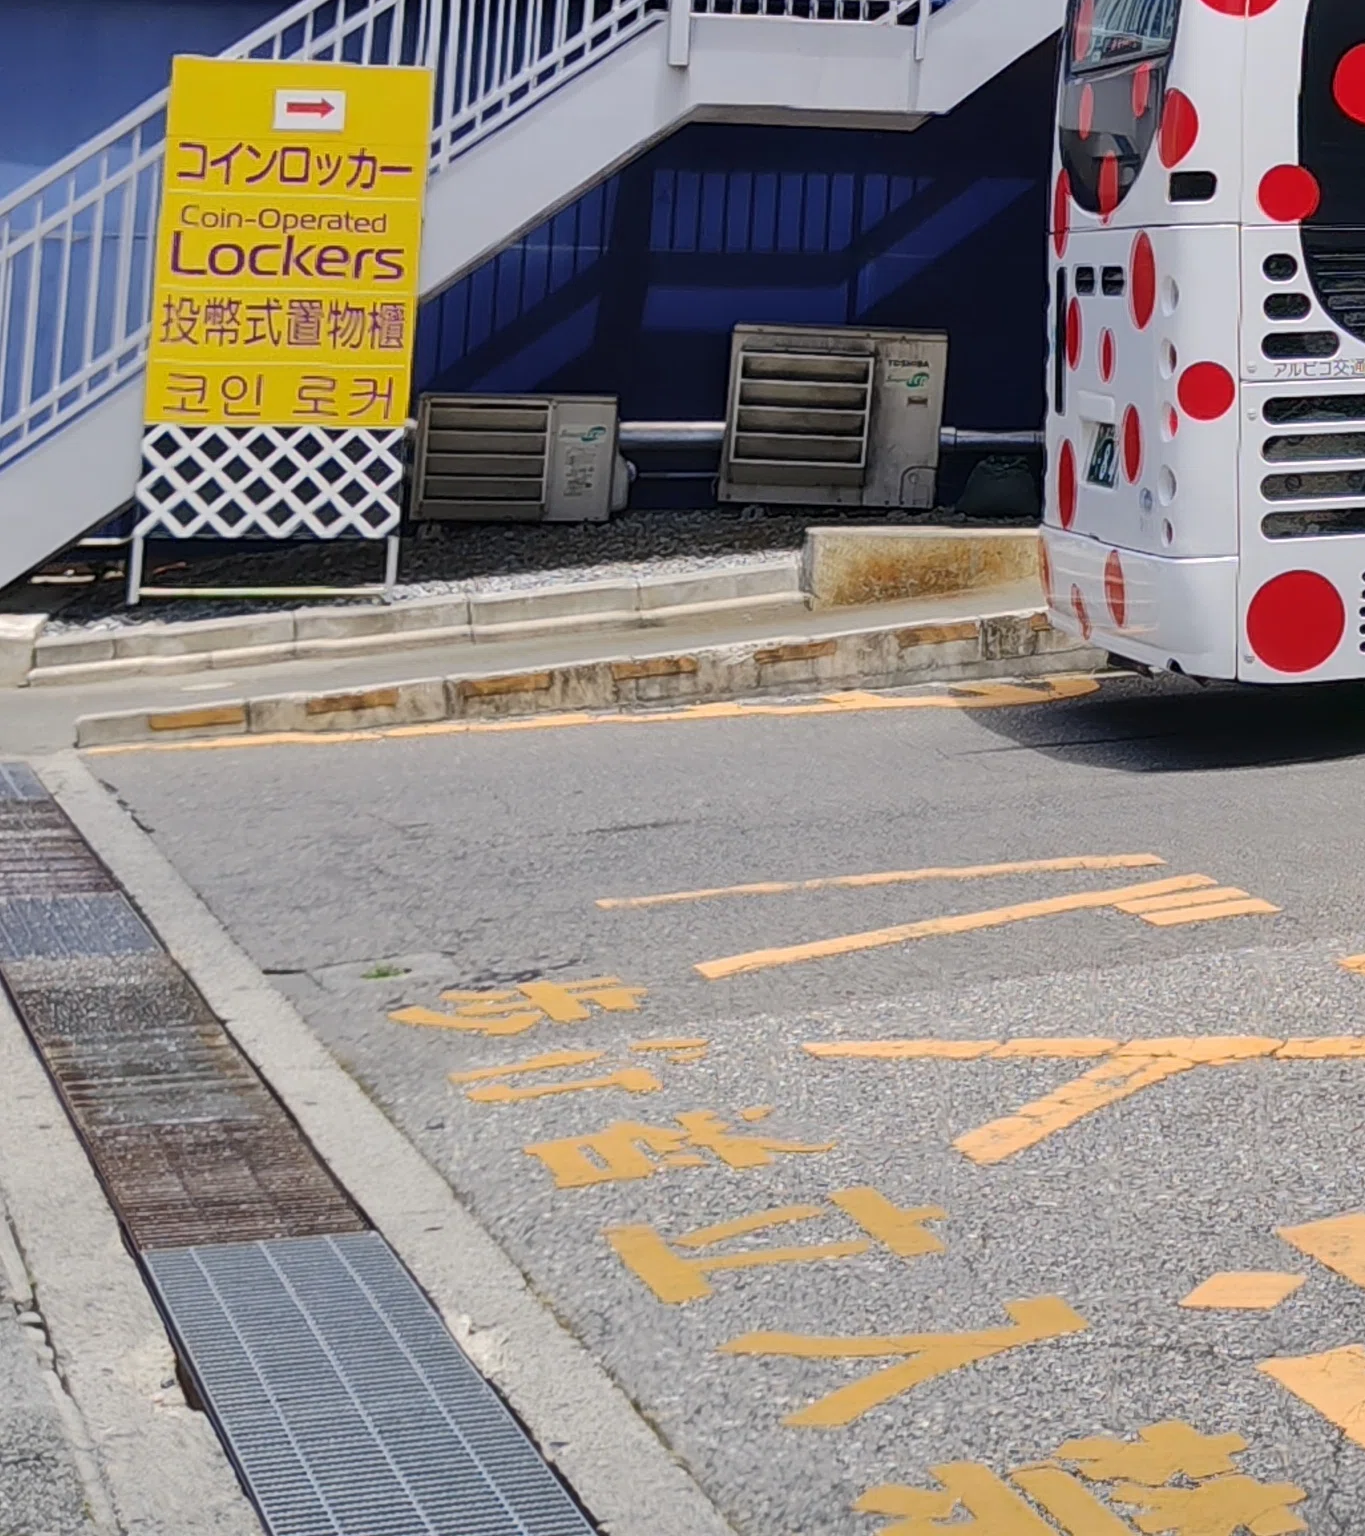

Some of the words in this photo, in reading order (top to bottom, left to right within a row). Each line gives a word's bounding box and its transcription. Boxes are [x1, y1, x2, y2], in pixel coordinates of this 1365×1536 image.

[176, 141, 413, 190] コインロッカー
[180, 203, 387, 234] Coin-Operated
[170, 230, 405, 281] Lockers
[159, 293, 406, 350] 投幣式置物櫃
[888, 359, 930, 369] TOSHIBA
[162, 372, 264, 417] 코인
[293, 375, 395, 420] 로커
